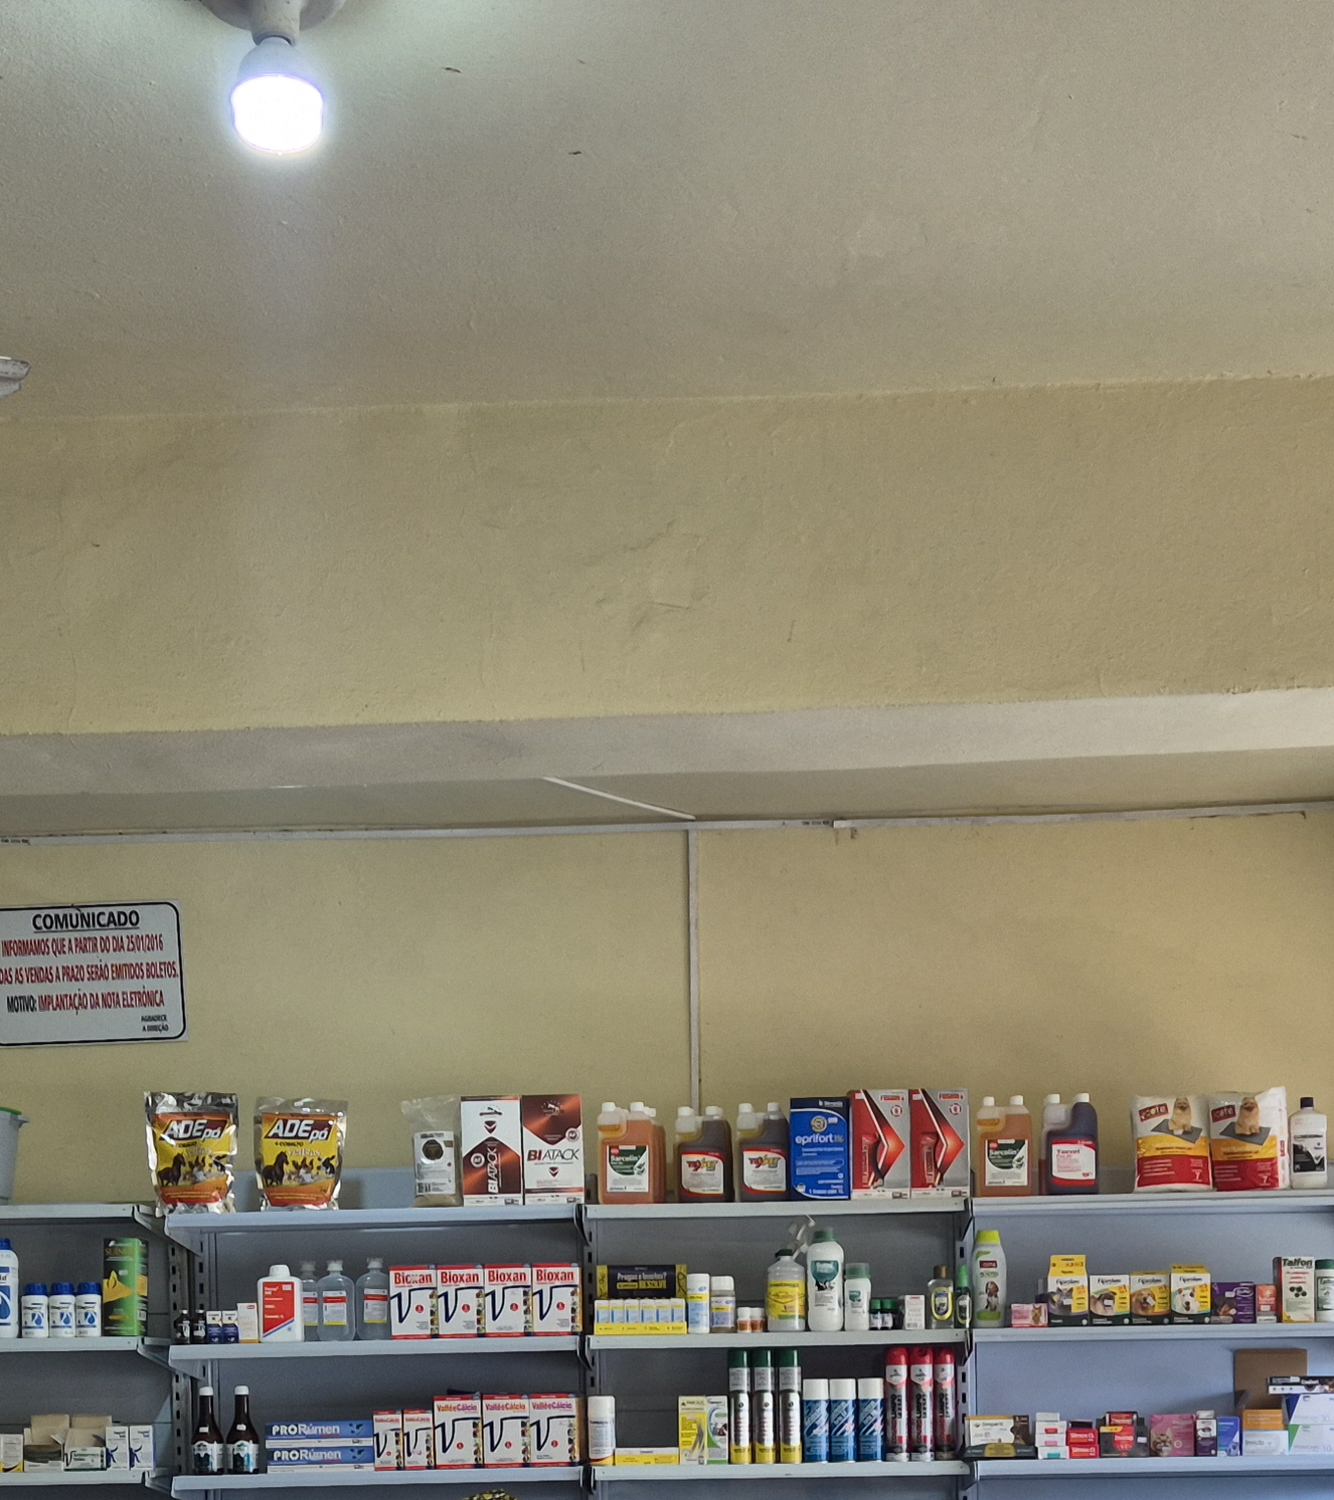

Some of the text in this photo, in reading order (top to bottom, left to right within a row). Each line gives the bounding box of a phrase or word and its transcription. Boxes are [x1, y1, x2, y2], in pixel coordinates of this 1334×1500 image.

[32, 910, 140, 930] COMUNICADO
[1, 934, 164, 957] INFORMAMOS QUE A PARTIR DO DIA 25/01/2016
[14, 967, 24, 984] AS
[25, 966, 53, 984] VENDAS
[55, 966, 61, 983] A
[62, 965, 85, 983] PRAZO
[86, 959, 110, 982] SERÃO
[111, 962, 144, 981] EMITIDOS
[145, 961, 179, 980] BOLETOS.
[7, 985, 164, 1014] MOTIVO: IMPLANTAÇÃO DA NOTA ELETRÔNICA
[270, 1119, 315, 1138] ADE
[795, 1133, 834, 1146] eprifort
[440, 1271, 479, 1284] Bioxan
[488, 1270, 527, 1284] Bioxan
[536, 1269, 574, 1282] Bioxan
